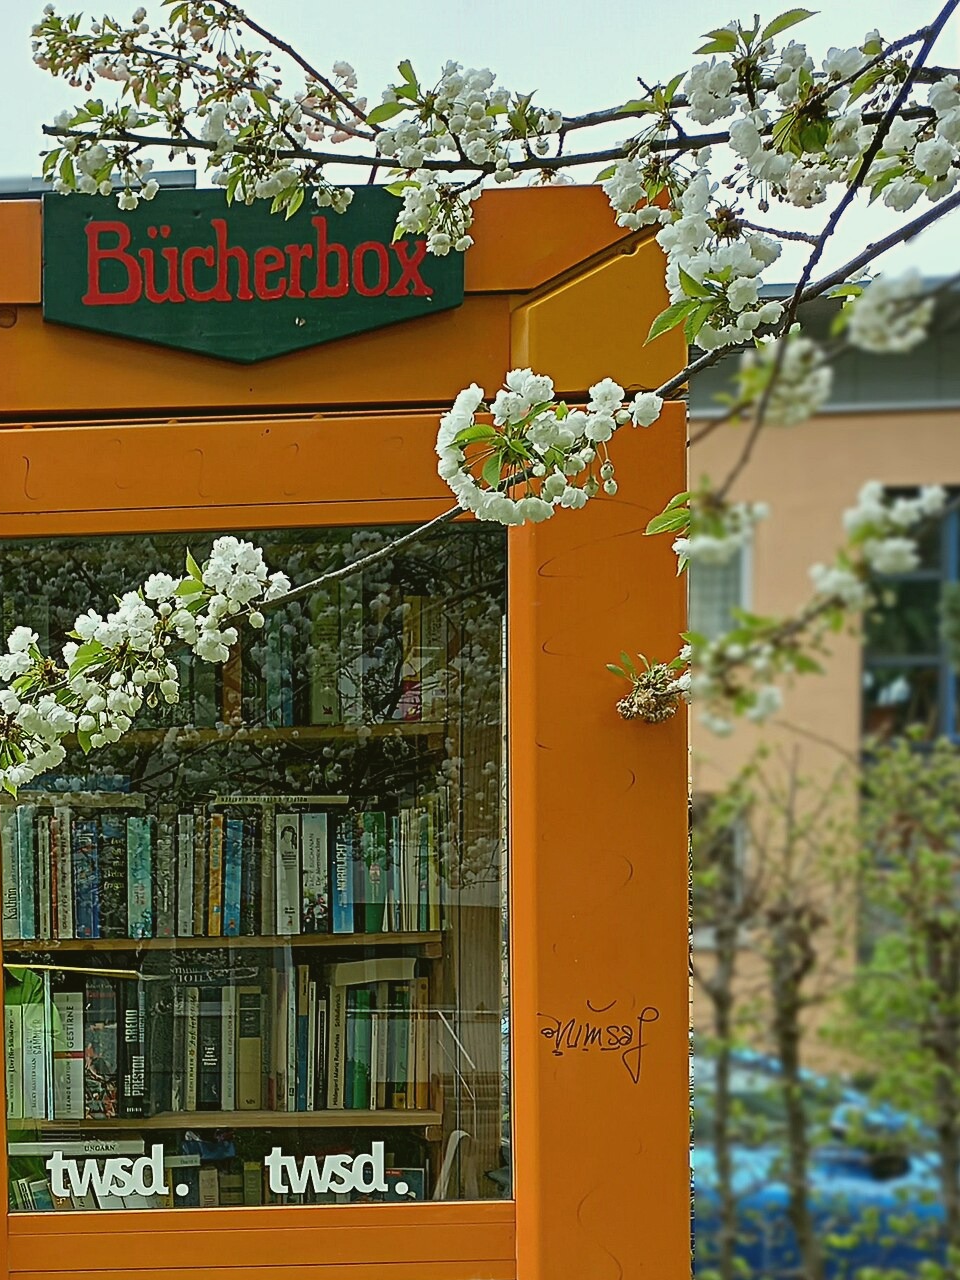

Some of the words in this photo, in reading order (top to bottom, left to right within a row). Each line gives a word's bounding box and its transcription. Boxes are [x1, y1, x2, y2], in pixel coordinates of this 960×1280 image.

[81, 215, 433, 306] Bücherbox
[336, 842, 348, 890] NORDLICHT
[5, 887, 17, 920] Kathrin
[65, 1005, 74, 1049] GESTIRNE
[125, 1009, 138, 1043] CREDO
[132, 1055, 145, 1097] PRESTON
[333, 1079, 341, 1106] Hildegard
